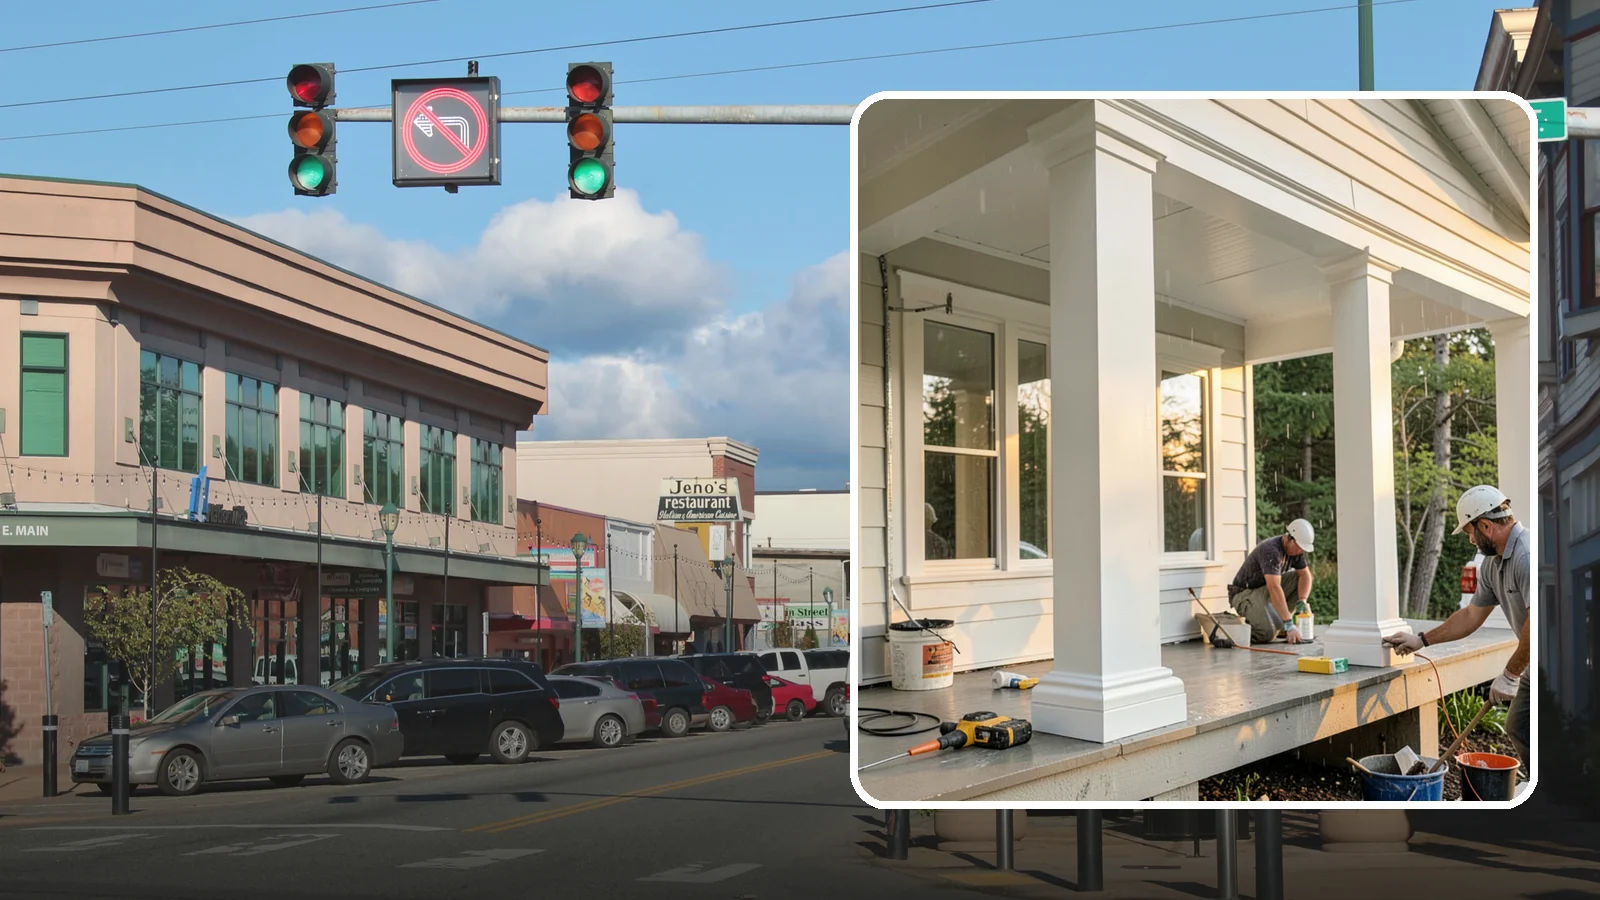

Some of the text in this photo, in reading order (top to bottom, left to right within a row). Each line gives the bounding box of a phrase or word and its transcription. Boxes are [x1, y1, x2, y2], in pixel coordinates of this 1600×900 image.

[670, 480, 727, 494] Jeno's
[665, 496, 731, 509] restaurant
[686, 510, 715, 519] American
[715, 509, 737, 519] Cuisine
[2, 525, 48, 536] E. MAIN
[786, 607, 828, 616] in Street
